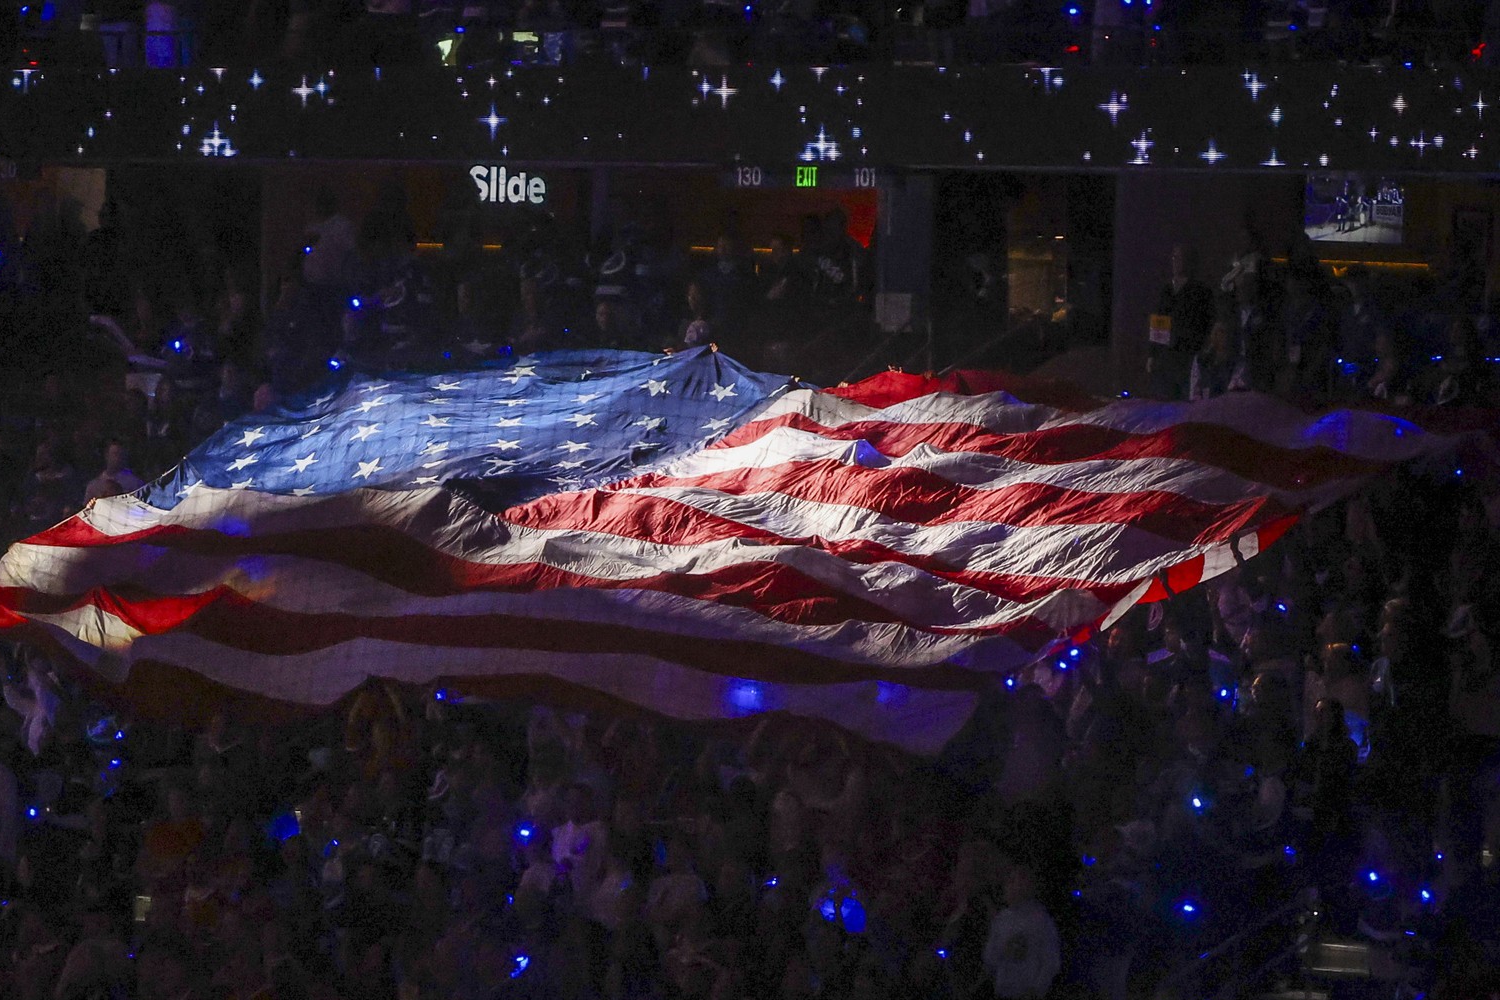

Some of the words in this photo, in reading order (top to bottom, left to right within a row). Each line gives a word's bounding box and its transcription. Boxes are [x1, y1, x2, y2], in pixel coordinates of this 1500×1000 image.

[737, 167, 762, 186] 130
[796, 166, 818, 187] EXIT
[854, 167, 876, 187] 101
